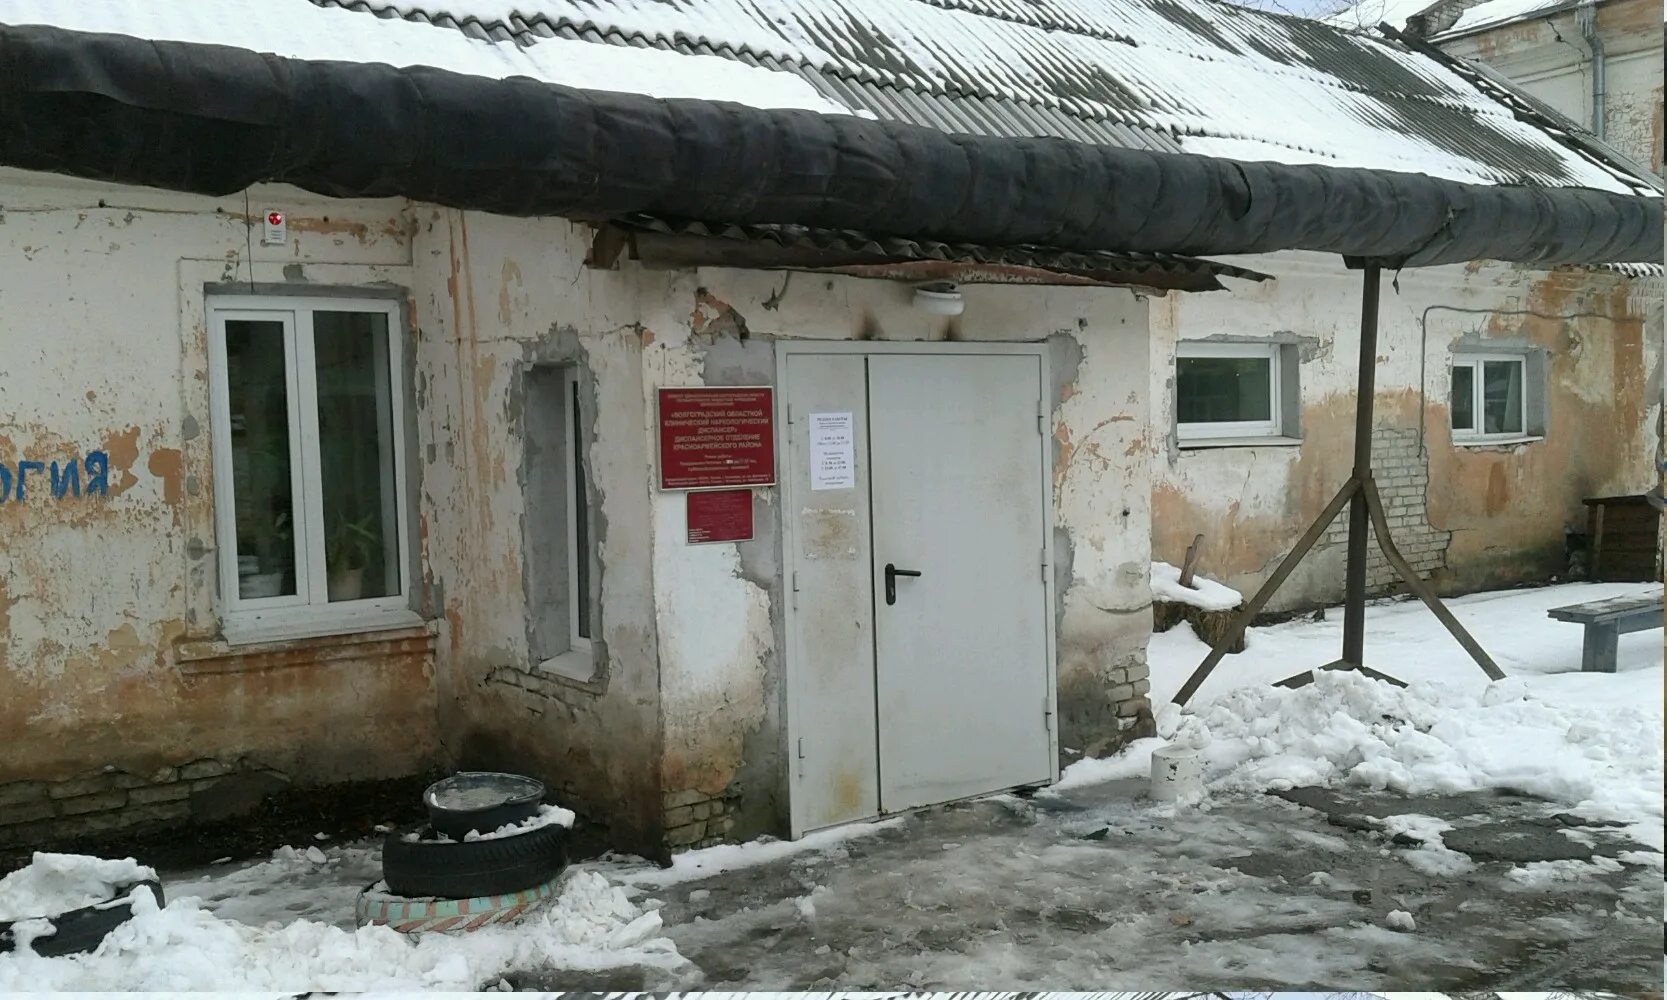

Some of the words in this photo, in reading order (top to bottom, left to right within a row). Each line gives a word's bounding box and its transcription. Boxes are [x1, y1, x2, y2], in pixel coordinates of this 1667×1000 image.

[726, 409, 763, 417] ОБЛАСТНОЙ
[664, 418, 710, 426] КЛИНИЧЕСКИЙ
[710, 416, 769, 425] НАРКОЛОГИЧЕСКИЙ
[674, 435, 725, 443] ДИСПАНСЕРНОЕ
[725, 433, 760, 441] ОТДЕЛЕНИЕ
[738, 441, 762, 449] РАЙОНА
